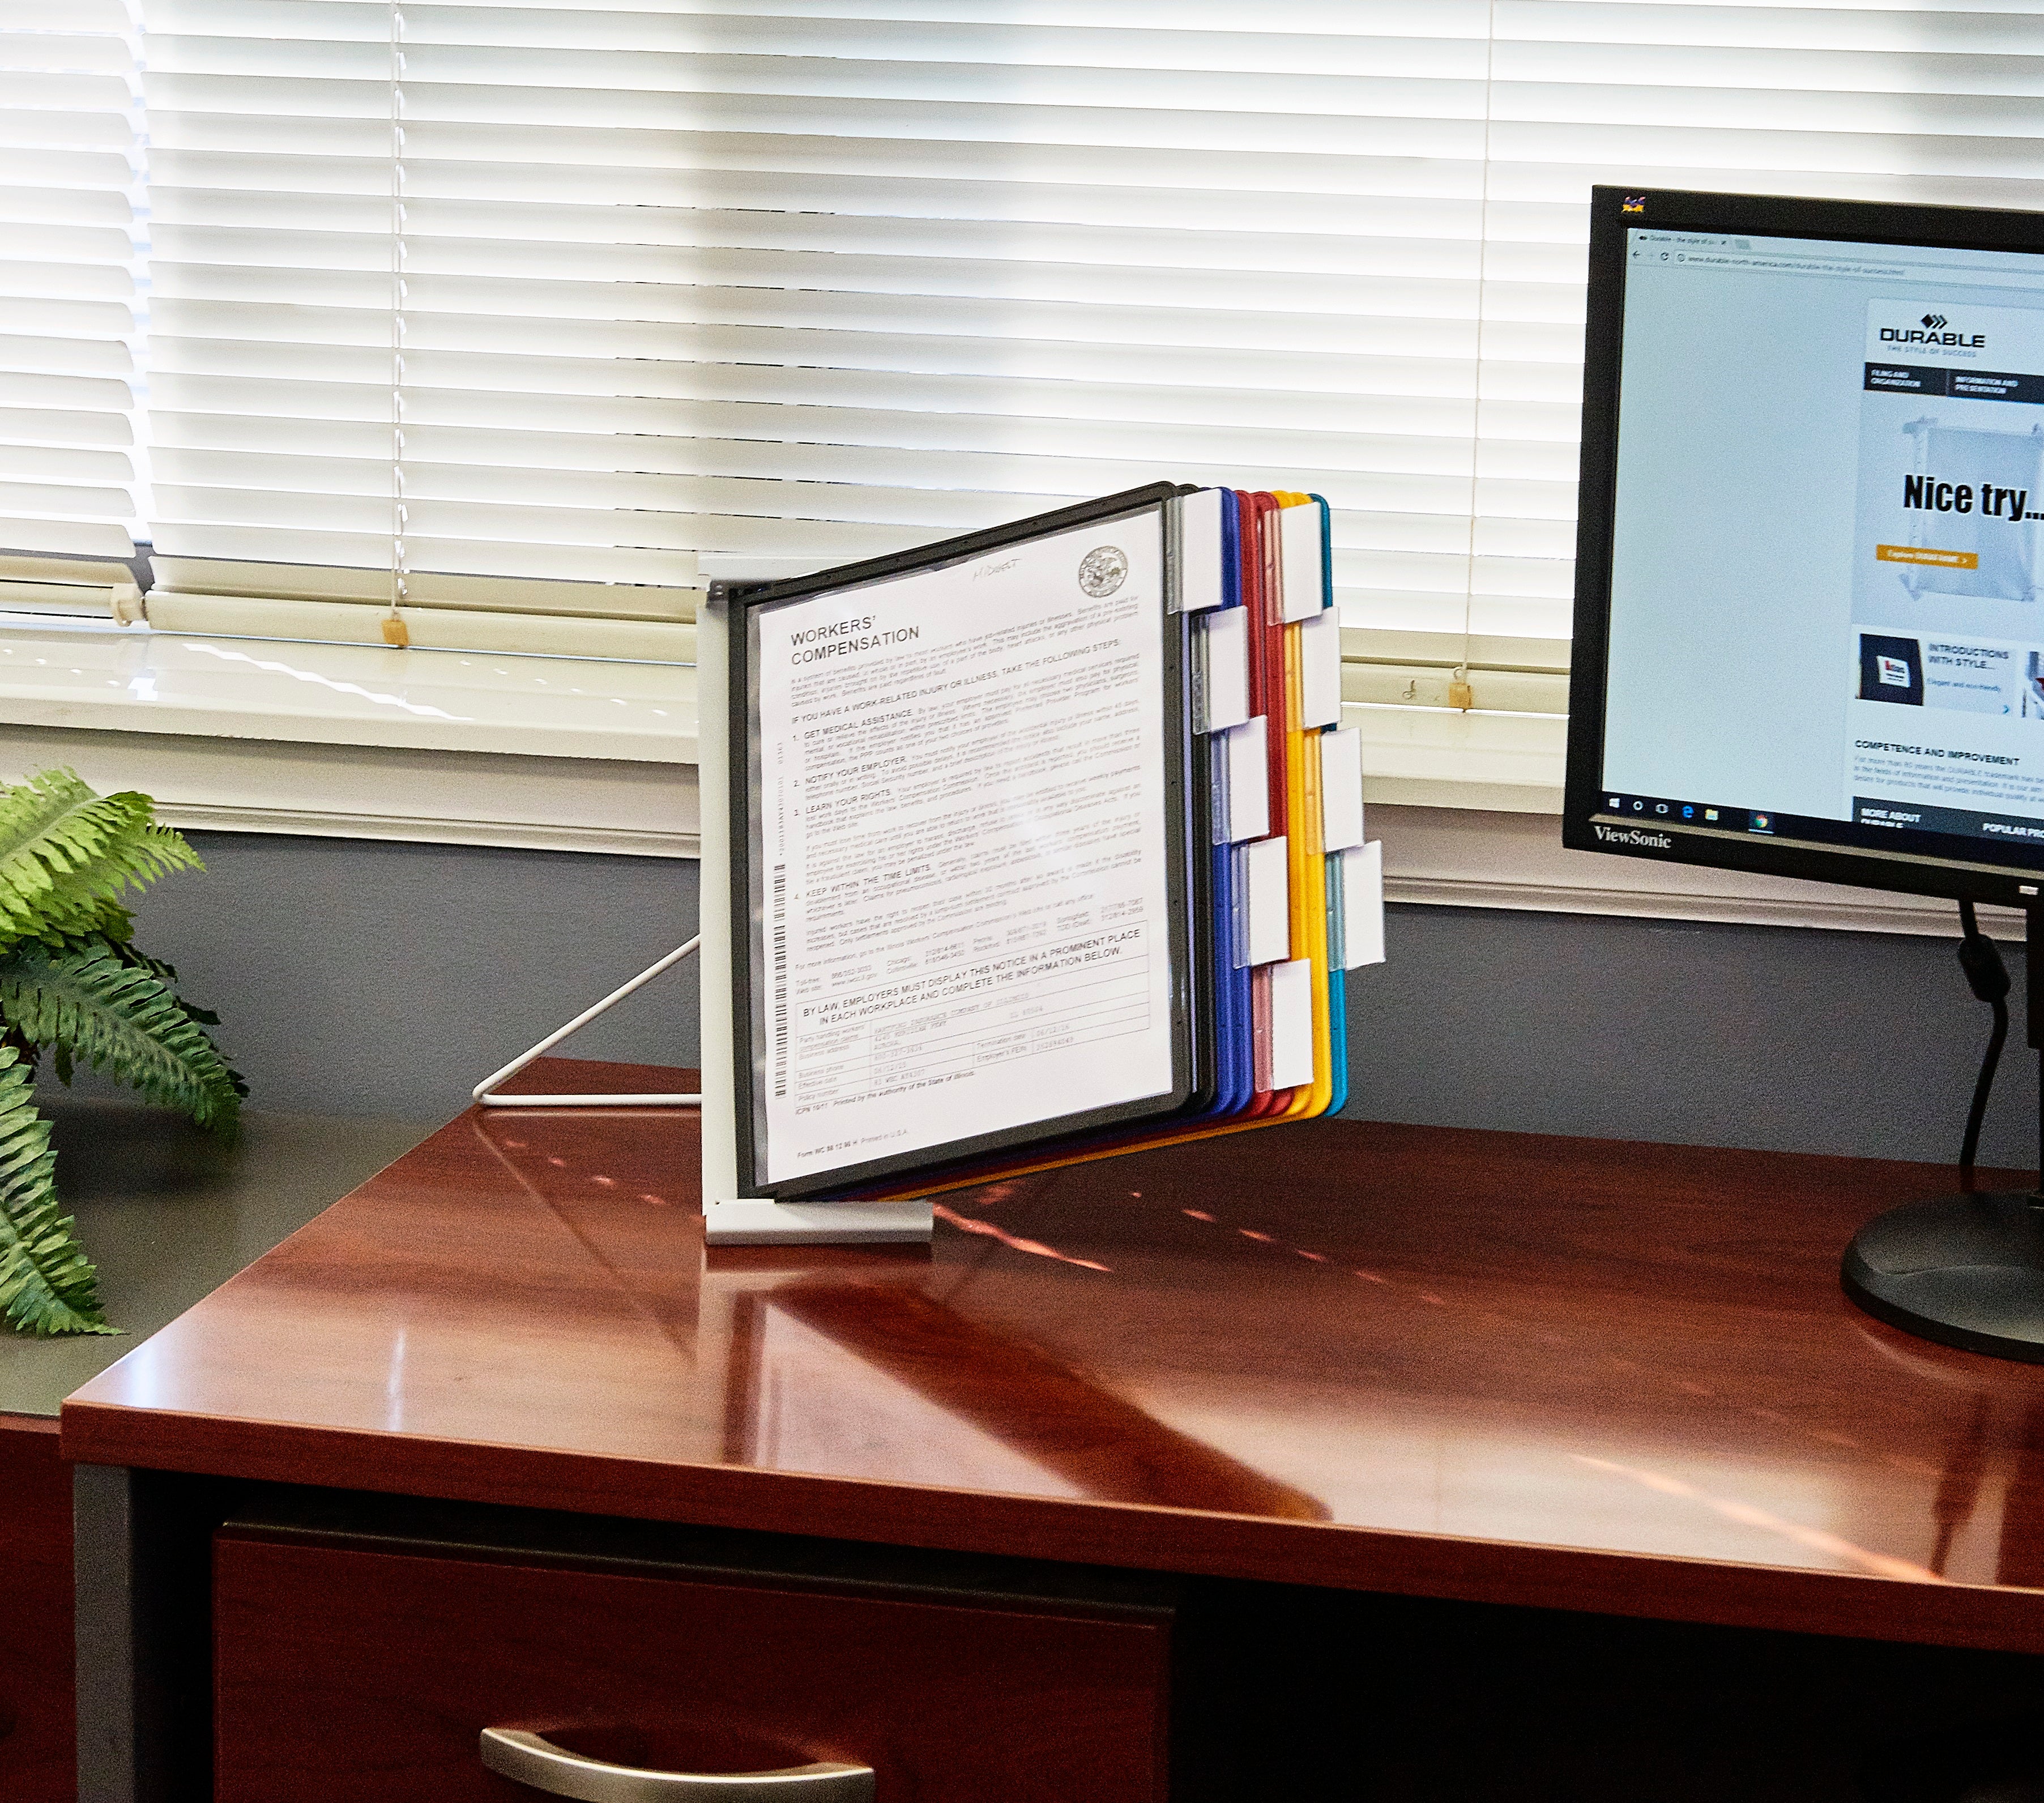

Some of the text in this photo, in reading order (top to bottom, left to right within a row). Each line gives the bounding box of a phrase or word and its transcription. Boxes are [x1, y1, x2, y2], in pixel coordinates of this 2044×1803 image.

[1879, 328, 1986, 348] DURABLE
[1904, 474, 1974, 514] Nice
[791, 616, 875, 646] WORKERS'
[792, 627, 919, 664] COMPENSATION
[1928, 643, 2009, 659] INTRODUCTIONS
[1928, 655, 1952, 666] WITH
[801, 713, 818, 722] YOU
[820, 707, 842, 718] HAVE
[852, 690, 917, 710] WORK-RELATED
[919, 684, 948, 696] INJURY
[950, 680, 962, 689] OR
[1002, 664, 1022, 674] TAKE
[1025, 659, 1040, 667] THE
[1043, 646, 1090, 664] FOLLOWING
[804, 729, 821, 739] GET
[822, 722, 859, 735] MEDICAL
[1855, 740, 2020, 765] COMPETENCE AND IMPROVEMENT
[805, 772, 834, 784] NOTIFY
[836, 766, 859, 777] YOUR
[806, 803, 832, 814] LEARN
[835, 796, 857, 806] YOUR
[1889, 811, 1922, 822] ABOUT
[1594, 825, 1672, 849] ViewSonic
[1983, 823, 2028, 836] POPULAR
[806, 887, 827, 897] KEEP
[831, 881, 859, 892] WITHIN
[863, 876, 879, 885] THE
[882, 871, 902, 881] TIME
[803, 1007, 816, 1017] BY
[843, 987, 898, 1008] EMPLOYERS
[902, 981, 926, 994] MUST
[928, 971, 967, 987] DISPLAY
[970, 965, 990, 976] THIS
[992, 956, 1026, 971] NOTICE
[1050, 937, 1105, 955] PROMINENT
[1108, 929, 1140, 943] PLACE
[820, 1016, 829, 1025] IN
[831, 1011, 856, 1023] EACH
[859, 995, 917, 1016] WORKPLACE
[920, 990, 939, 1001] AND
[942, 977, 993, 996] COMPLETE
[996, 971, 1014, 983] THE
[1017, 957, 1081, 977] INFORMATION
